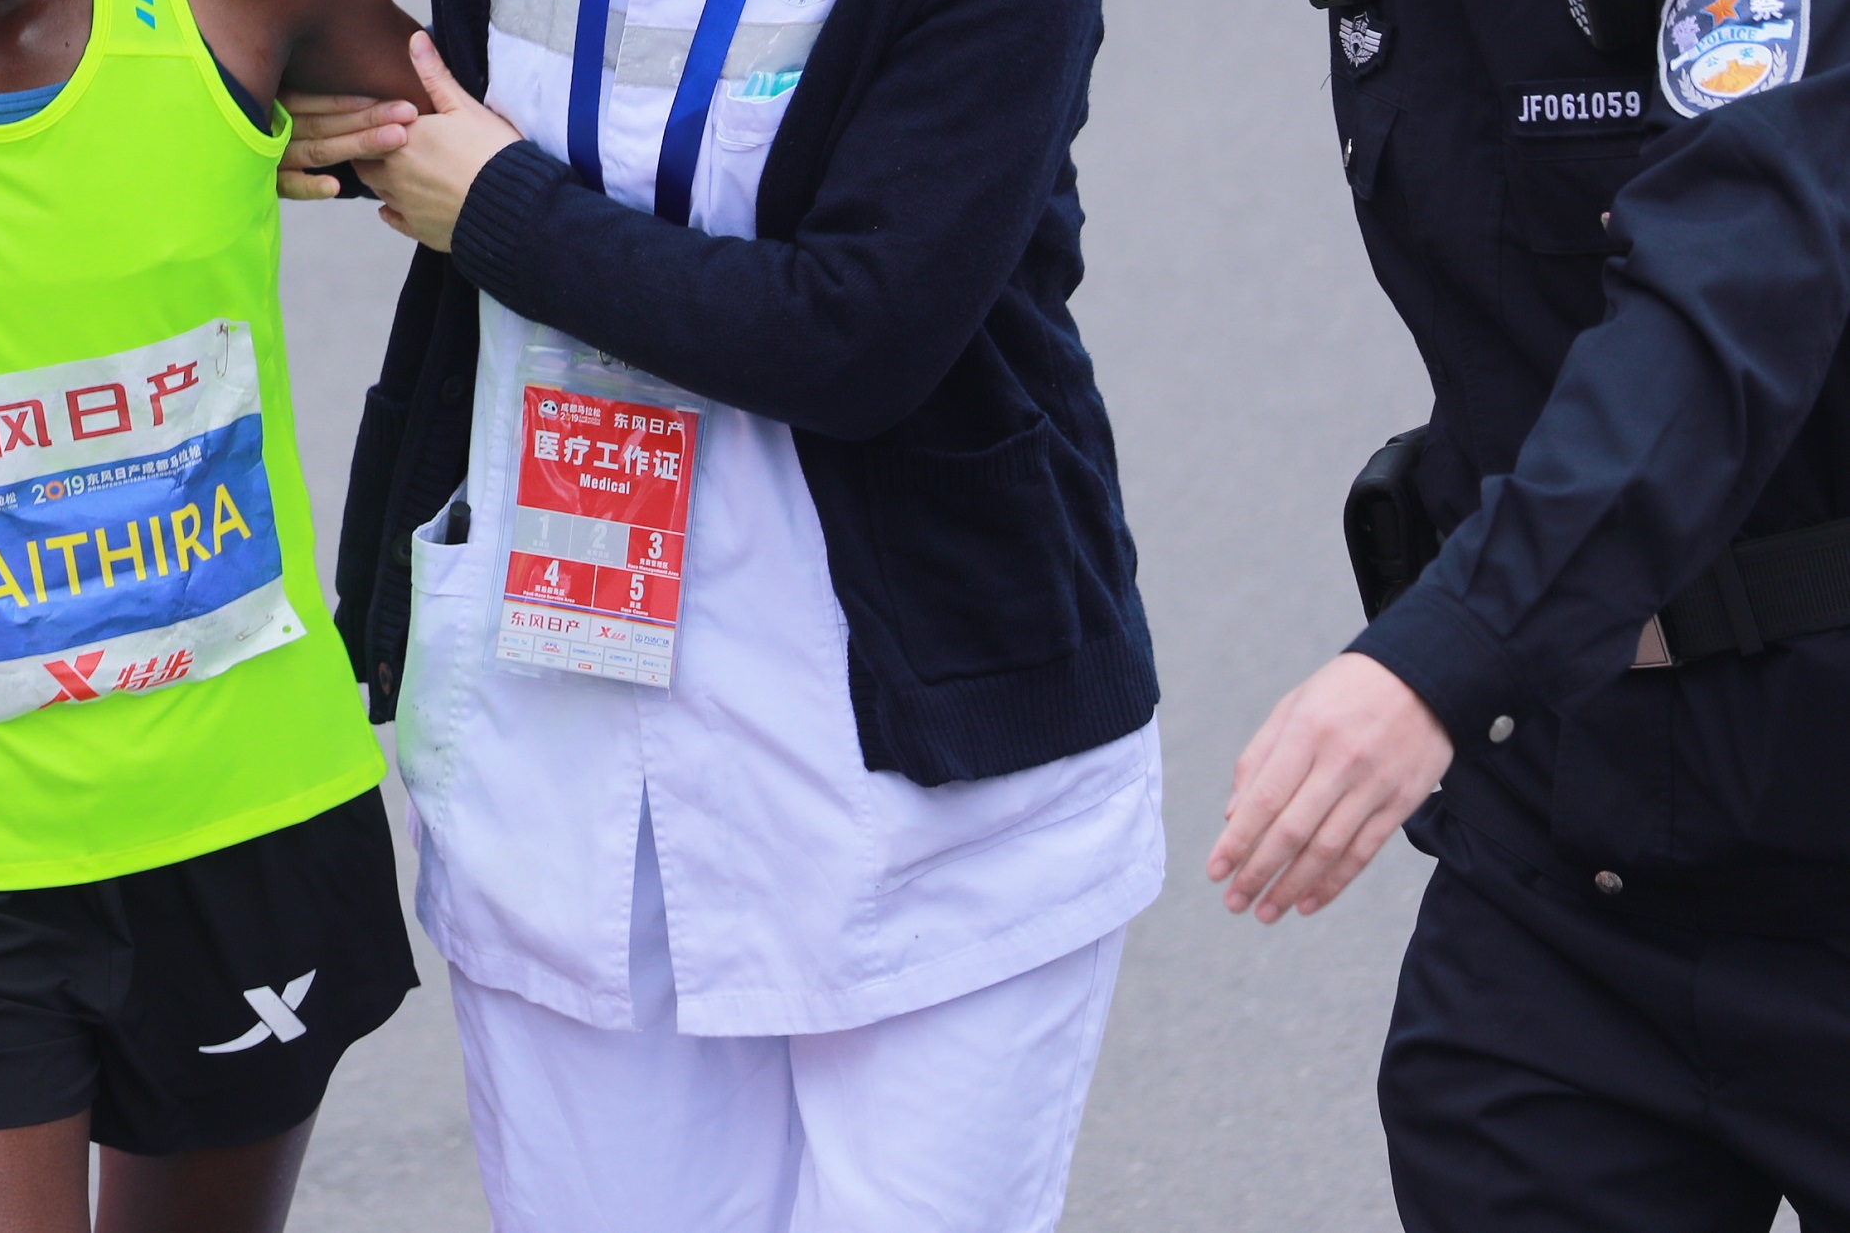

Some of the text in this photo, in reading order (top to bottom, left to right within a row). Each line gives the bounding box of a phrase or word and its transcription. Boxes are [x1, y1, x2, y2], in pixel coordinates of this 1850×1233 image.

[1697, 28, 1758, 53] POLICE
[1518, 92, 1641, 122] JF061059
[560, 403, 601, 417] 成都马拉松
[614, 413, 684, 436] 东风日产
[534, 430, 679, 481] 医疗工作证
[31, 475, 86, 506] 2019
[87, 444, 201, 485] 东风日产成都马拉松
[580, 473, 631, 494] Medical
[593, 523, 607, 549] 2
[648, 532, 663, 559] 3
[544, 560, 644, 601] 4 5
[510, 611, 581, 634] 东风日产
